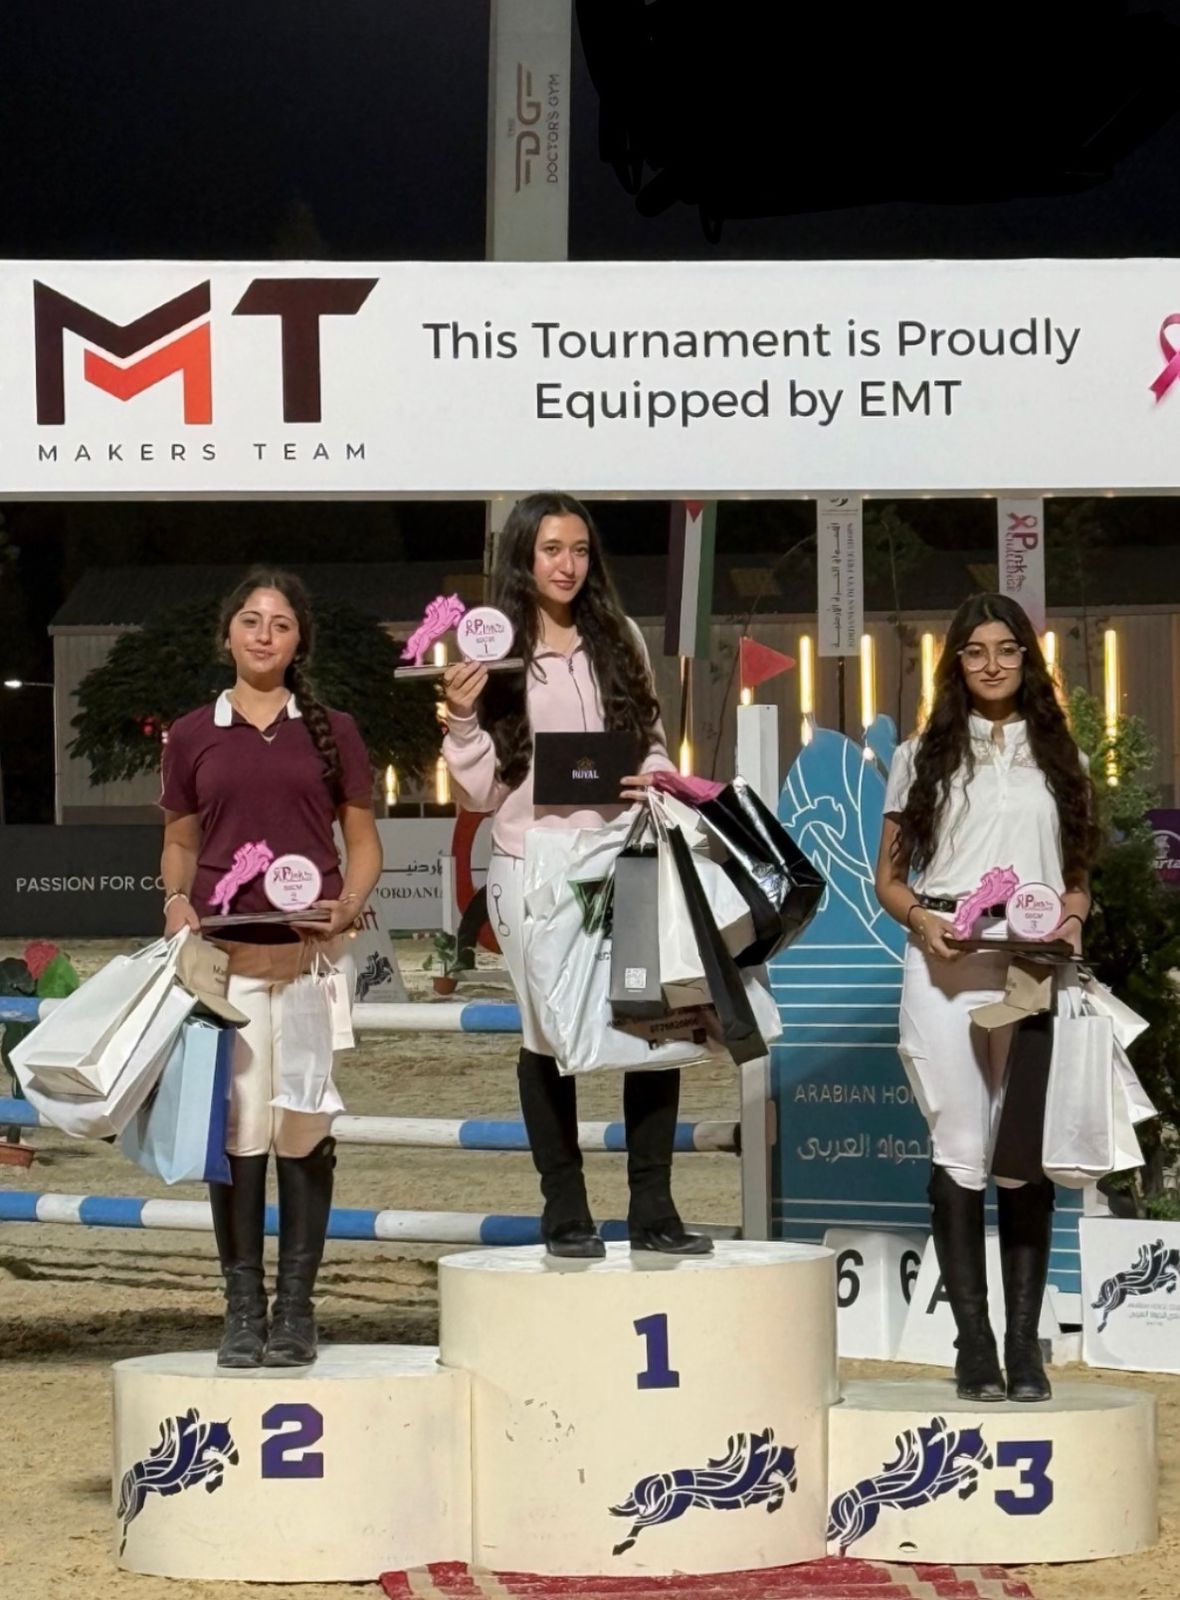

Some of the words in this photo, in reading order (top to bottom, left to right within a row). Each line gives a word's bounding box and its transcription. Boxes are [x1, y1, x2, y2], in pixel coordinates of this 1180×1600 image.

[548, 74, 560, 106] GYM
[423, 321, 518, 359] This
[531, 322, 831, 359] Tournament
[847, 319, 881, 357] is
[898, 317, 1081, 365] Proudly
[536, 379, 769, 428] Equipped
[789, 379, 844, 427] by
[860, 380, 962, 417] EMT
[38, 443, 216, 462] MAKERS
[253, 443, 365, 461] TEAM
[572, 769, 599, 779] ROYAL
[16, 876, 95, 893] PASSION
[100, 876, 135, 891] FOR
[140, 876, 166, 891] CO
[376, 887, 443, 899] ORDANI
[794, 1084, 876, 1104] ARABIAN
[882, 1085, 916, 1105] HO
[836, 1249, 864, 1308] 6
[633, 1312, 680, 1390] 1
[261, 1403, 324, 1479] 2
[994, 1439, 1054, 1516] 3
